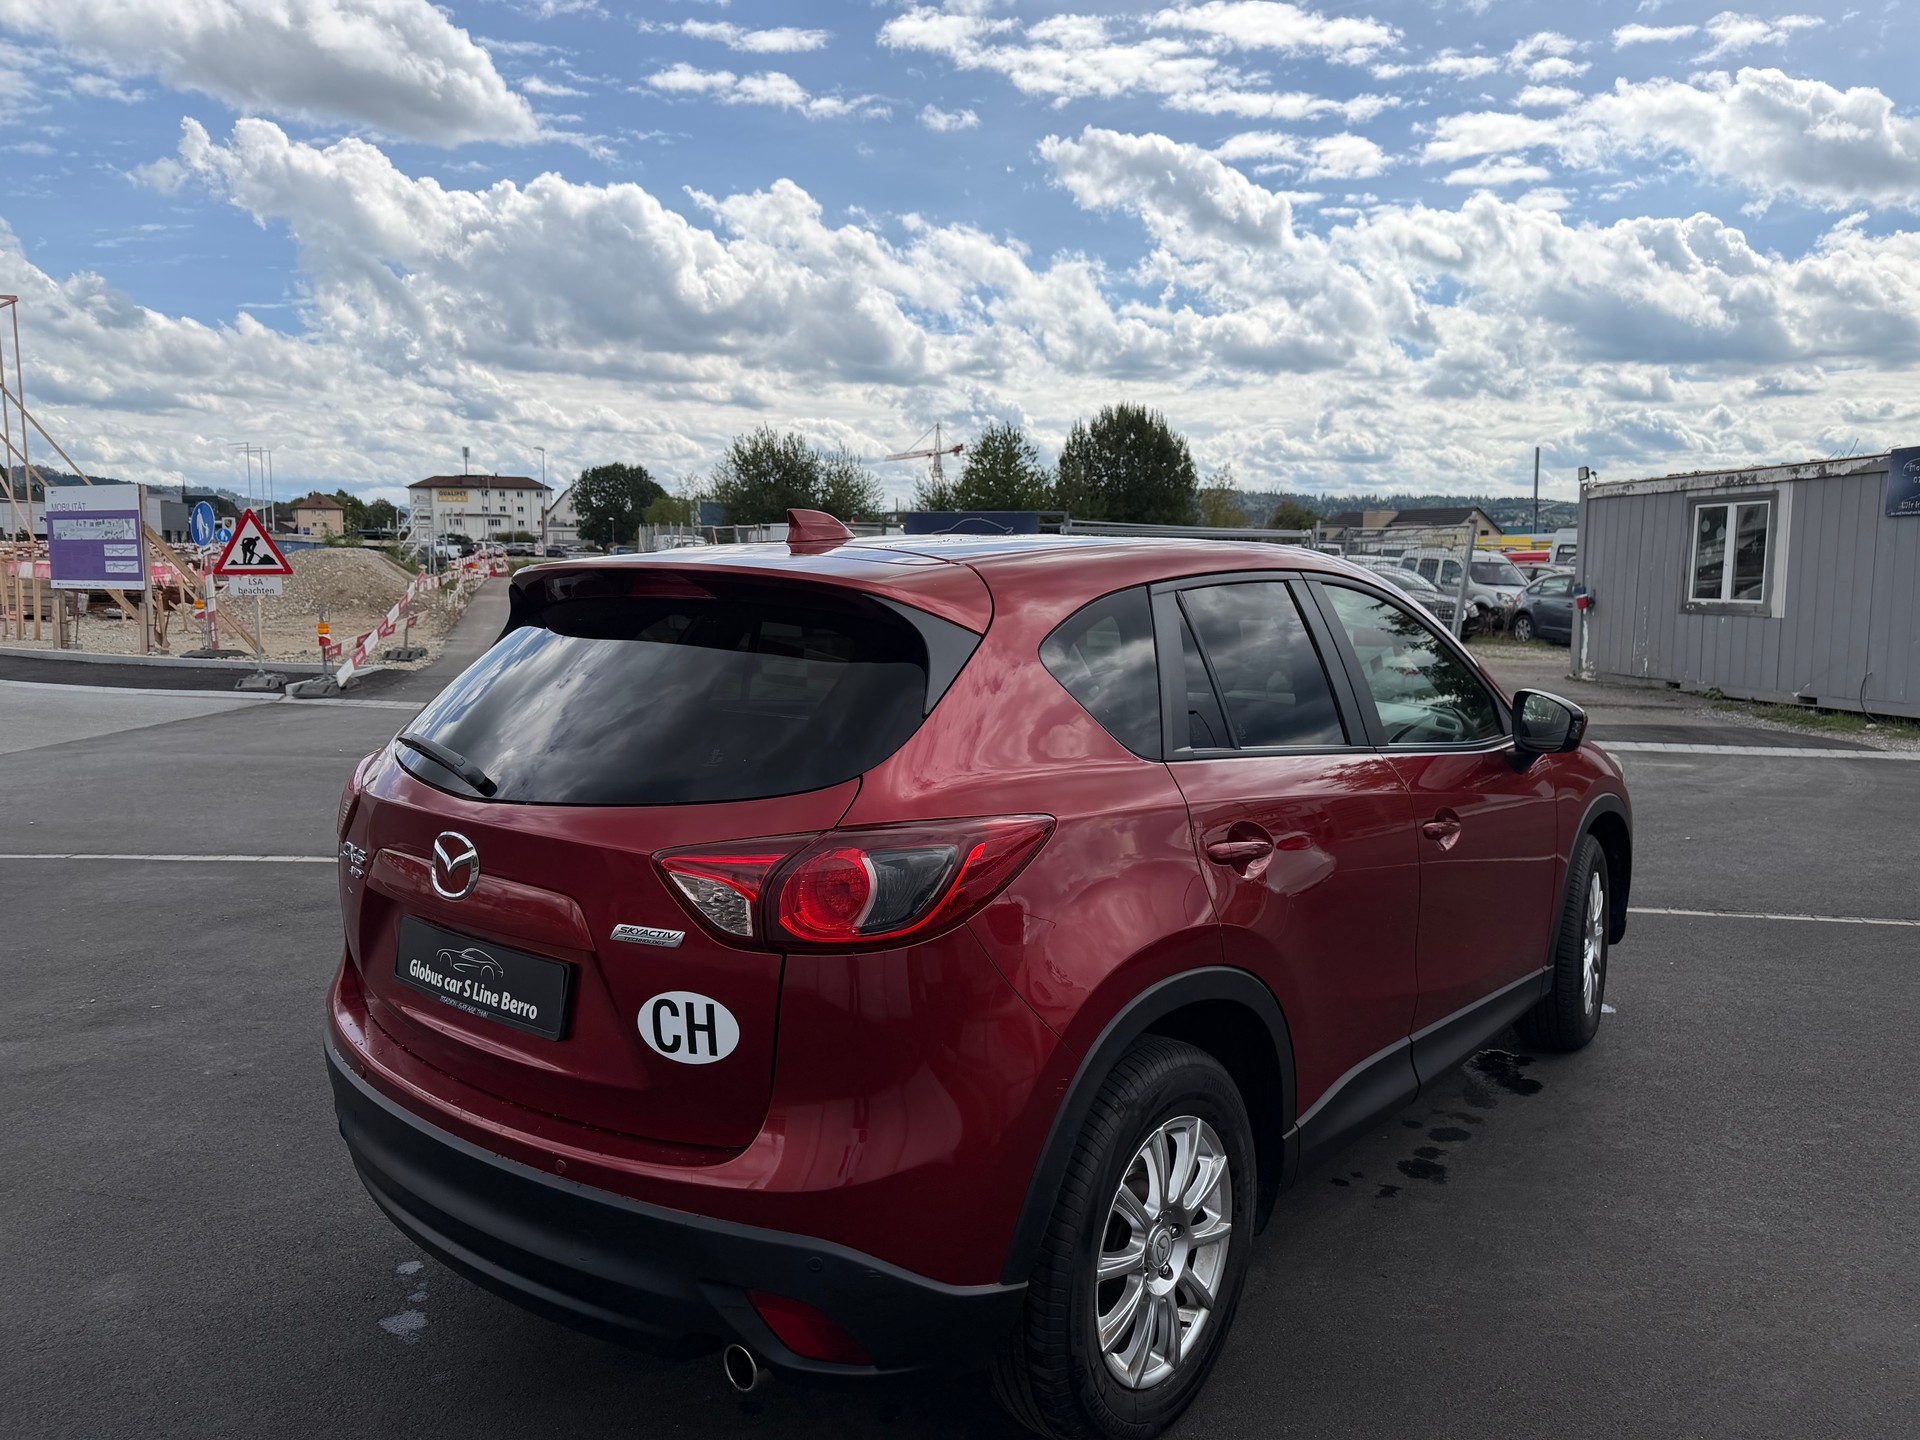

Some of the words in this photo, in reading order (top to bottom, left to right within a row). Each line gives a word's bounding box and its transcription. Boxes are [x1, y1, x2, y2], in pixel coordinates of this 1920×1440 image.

[51, 502, 86, 512] MOBILITÄT
[248, 578, 263, 586] LSA
[238, 587, 275, 595] beachten
[618, 926, 678, 939] SKYACTIV
[623, 937, 667, 946] TECHNOLOGY
[409, 959, 443, 987] Globus
[444, 977, 462, 994] car
[463, 979, 472, 998] S
[472, 982, 499, 1007] Line
[500, 991, 538, 1020] Berro
[652, 998, 718, 1057] CH
